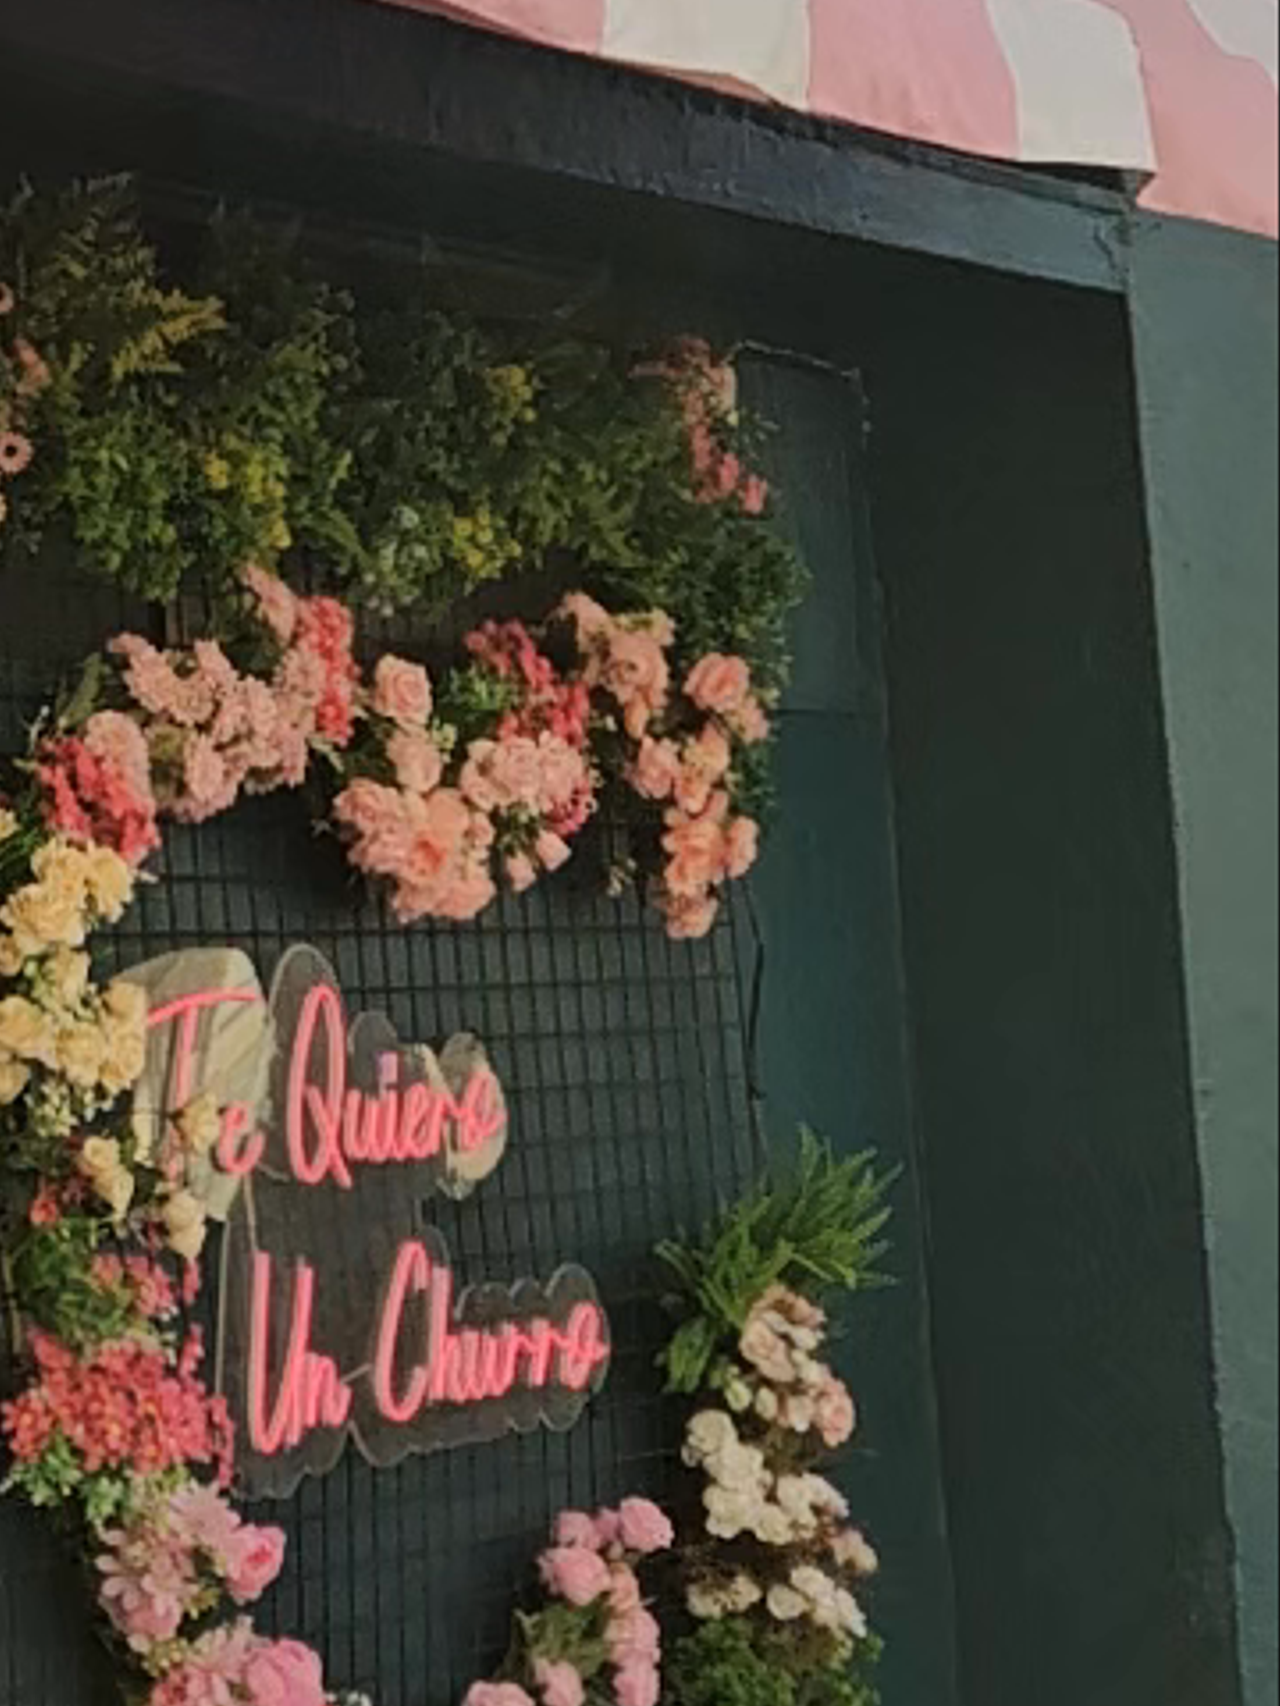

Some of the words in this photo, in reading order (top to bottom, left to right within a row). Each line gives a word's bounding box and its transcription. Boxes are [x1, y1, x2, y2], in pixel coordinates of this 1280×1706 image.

[146, 988, 266, 1182] Te
[287, 984, 504, 1189] Quiero
[248, 1250, 351, 1455] Un
[376, 1240, 610, 1422] Churro
